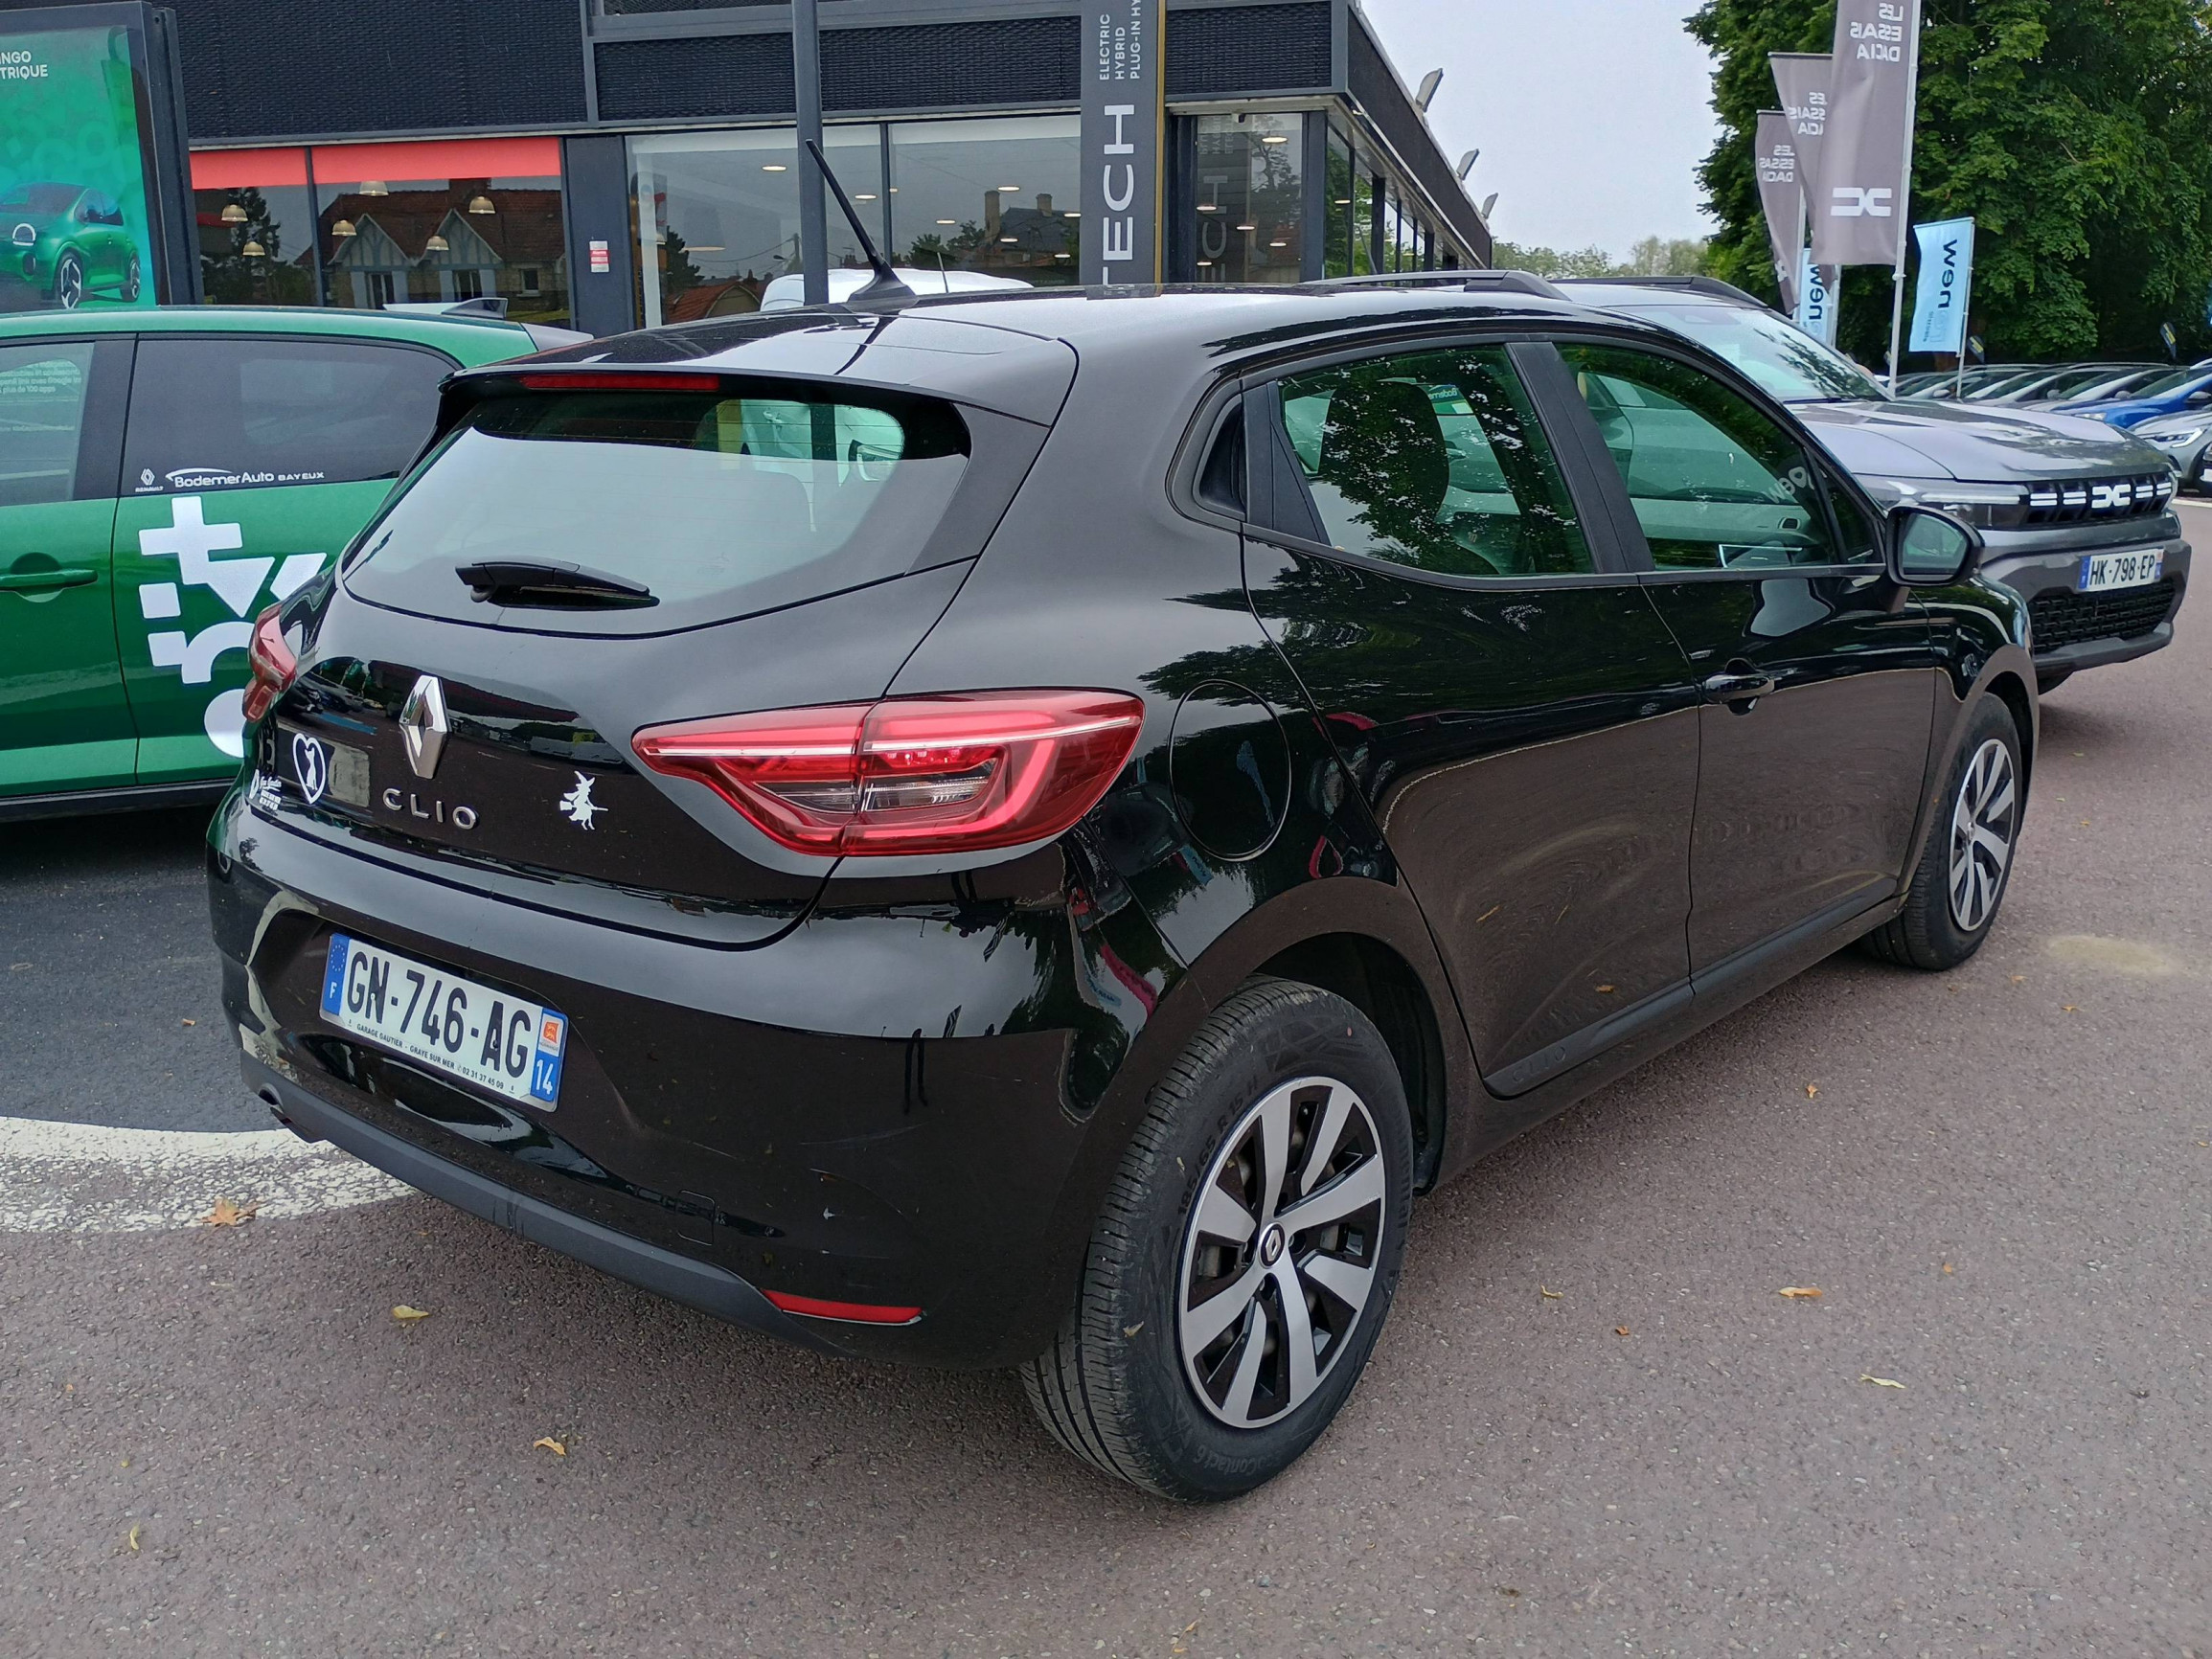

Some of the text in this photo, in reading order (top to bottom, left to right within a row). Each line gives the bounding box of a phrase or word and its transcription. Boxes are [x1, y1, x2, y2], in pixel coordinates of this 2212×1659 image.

[0, 51, 32, 64] NGO
[1099, 13, 1110, 80] ELECTRIC
[1114, 27, 1126, 80] HYBRID
[1129, 20, 1141, 80] PLUG-IN
[174, 471, 325, 488] BodemerAuto BAYEUX
[2089, 555, 2155, 585] HK-798-EP
[383, 787, 477, 830] CLIO
[329, 982, 337, 999] F
[347, 951, 532, 1079] GN-746-AG
[356, 1023, 378, 1038] GARAGE
[378, 1033, 403, 1049] GAUTIER
[409, 1045, 428, 1058] GRAYE
[429, 1053, 442, 1065] SUR
[442, 1057, 455, 1070] MER
[462, 1067, 470, 1076] 02
[470, 1070, 478, 1079] 31
[478, 1073, 487, 1082] 37
[487, 1077, 495, 1086] 45
[496, 1079, 504, 1090] 09
[536, 1059, 554, 1095] 14
[1203, 1449, 1281, 1476] oContact
